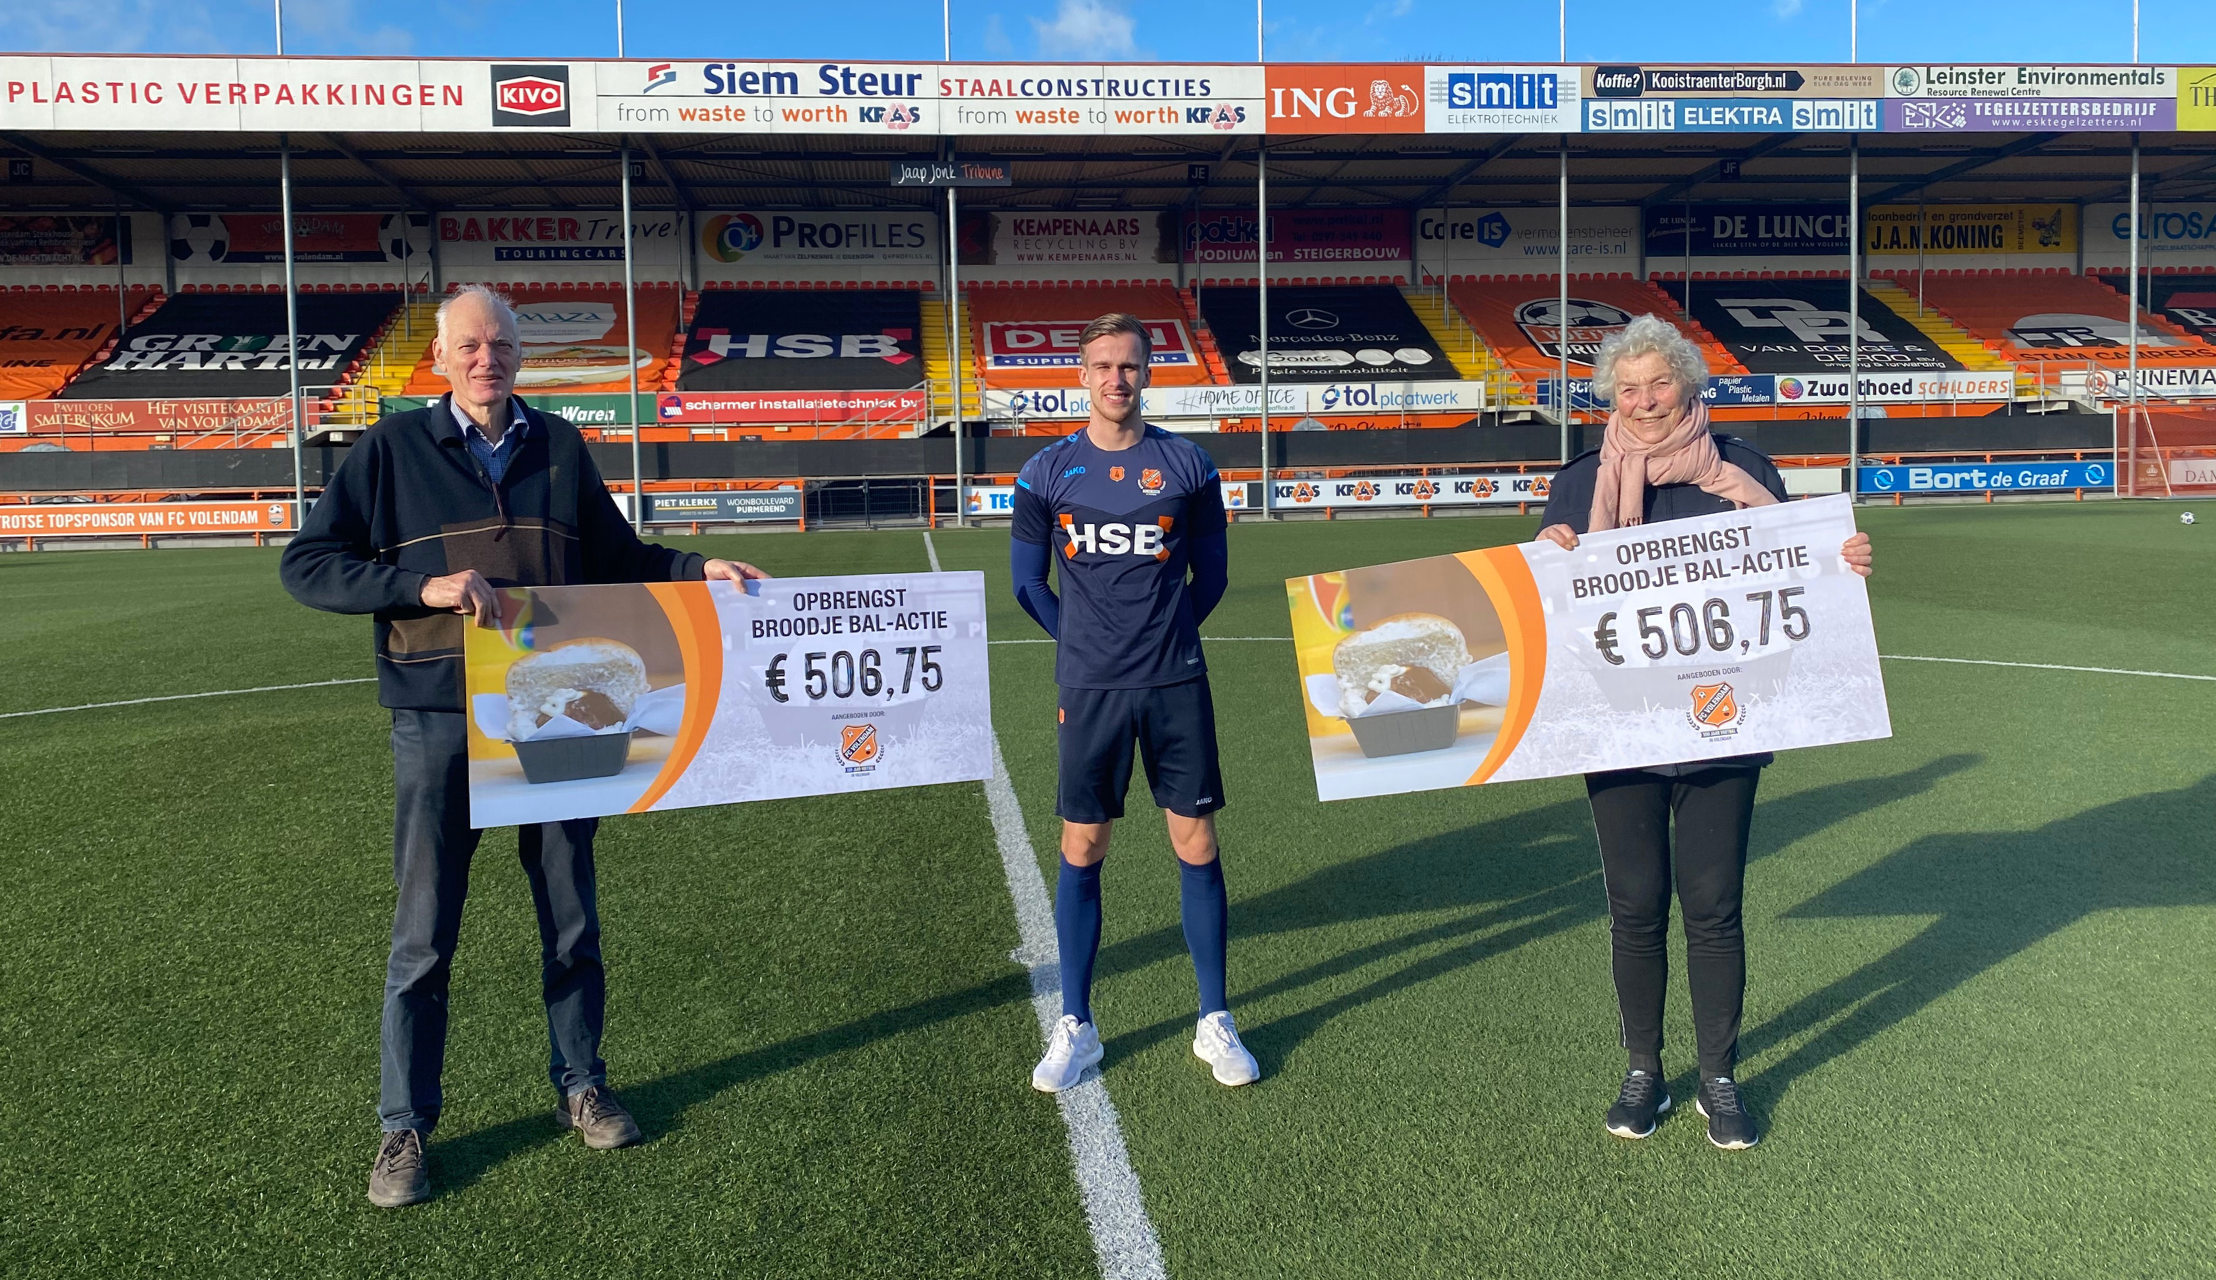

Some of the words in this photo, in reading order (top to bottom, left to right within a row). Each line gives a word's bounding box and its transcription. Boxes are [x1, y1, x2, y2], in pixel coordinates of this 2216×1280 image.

[703, 64, 799, 95] Siem
[819, 65, 922, 97] Steur
[1596, 73, 1642, 89] Koffie?
[1652, 71, 1786, 92] KooistraenterBorgh.nl
[1926, 67, 2005, 86] Leinster
[2016, 66, 2165, 87] Environmentals
[7, 81, 163, 104] PLASTIC
[177, 83, 463, 106] VERPAKKINGEN
[939, 78, 1211, 98] STAALCONSTRUCTIES
[1449, 73, 1557, 109] smit
[1927, 88, 1967, 98] Resource
[1970, 88, 2008, 98] Renewal
[2010, 87, 2041, 98] Centre
[503, 87, 558, 105] KIVO
[1270, 87, 1357, 119] ING
[618, 104, 669, 122] from
[678, 105, 746, 122] waste
[753, 103, 774, 122] to
[782, 104, 848, 122] worth
[859, 106, 920, 123] KRAS
[957, 106, 1007, 124] from
[1015, 107, 1080, 124] waste
[1088, 105, 1108, 124] to
[1114, 105, 1179, 124] worth
[1186, 107, 1246, 124] KRAS
[1589, 102, 1675, 130] smit
[1684, 107, 1783, 125] ELEKTRA
[1792, 101, 1877, 130] smit
[1974, 102, 2157, 118] TEGELZETTERSBEDRIJF
[1448, 114, 1559, 125] ELEKTROTECHNIEK
[1992, 118, 2142, 129] www.esktegelzetters.nl
[13, 163, 30, 176] JC
[898, 164, 927, 184] Jaap
[928, 164, 956, 184] Jonk
[961, 164, 1004, 180] Tribune
[1191, 167, 1205, 179] JE
[1723, 162, 1737, 174] JF
[1931, 212, 1945, 220] en
[1949, 211, 2014, 224] grondverzet
[262, 217, 344, 235] VOENDAM
[440, 217, 582, 242] BAKKER
[772, 216, 926, 248] PROFILES
[1012, 218, 1140, 236] KEMPENAARS
[1483, 221, 1503, 240] IS
[1516, 226, 1633, 241] vermoensbeheer
[1713, 215, 1749, 239] DE
[1757, 214, 1851, 239] LUNCH
[1013, 239, 1108, 249] RECYCLING
[1119, 239, 1141, 249] B.V.
[501, 249, 628, 259] TOURINGCARS
[1017, 253, 1138, 262] WWW.KEMPENAARS.NL
[1293, 247, 1401, 260] STEIGERBOUW
[516, 312, 605, 323] MAZA
[708, 333, 900, 358] HSB
[1250, 333, 1399, 344] Mercedes-Benz
[1739, 345, 1798, 353] VAN
[2019, 352, 2091, 362] STAM
[1304, 367, 1335, 376] voor
[1339, 366, 1409, 376] mobiliteit
[1728, 385, 1753, 395] Plastic
[1807, 378, 1913, 397] Zwathoed
[1917, 380, 2009, 395] SCHILDERS
[1033, 390, 1068, 413] tol
[1343, 383, 1378, 406] tol
[1380, 390, 1459, 409] plaatwerk
[1741, 393, 1770, 404] Metalen
[53, 402, 114, 413] PAVILJOEN
[183, 401, 286, 415] VISITEKAARTJE
[685, 399, 757, 412] schermer
[759, 397, 898, 412] installatietechniek
[900, 398, 918, 411] bv
[158, 417, 190, 429] VAN
[1063, 466, 1086, 478] JAKO
[1909, 466, 1987, 489] Bort
[1990, 469, 2013, 487] de
[2018, 466, 2070, 488] Graaf
[1274, 485, 1321, 499] KRAS
[1335, 483, 1382, 497] KRAS
[1394, 480, 1441, 496] KRAS
[1454, 478, 1500, 493] KRAS
[1513, 478, 1549, 493] KRA
[655, 499, 676, 508] PIET
[679, 498, 717, 507] KLERKX
[727, 497, 794, 506] WOONBOULEVARD
[49, 509, 135, 528] TOPSPONSOR
[138, 507, 165, 526] VAN
[167, 506, 186, 524] FC
[189, 504, 259, 525] VOLENDAM
[737, 505, 786, 514] PURMEREND
[1066, 522, 1165, 555] HSB
[1616, 525, 1753, 565] OPBRENGST
[1571, 565, 1678, 598] BROODJE
[1684, 545, 1810, 588] BAL-ACTIE
[793, 588, 907, 612] OPBRENGST
[751, 616, 843, 639] BROODJE
[849, 611, 949, 634] BAL-ACTIE
[1593, 612, 1625, 665] €
[1636, 586, 1812, 660] 506,75
[765, 653, 790, 703] €
[804, 645, 944, 702] 506,75
[1677, 670, 1721, 681] AANGEBODEN
[1722, 666, 1743, 675] DOOR:
[831, 712, 868, 721] AANGEBODEN
